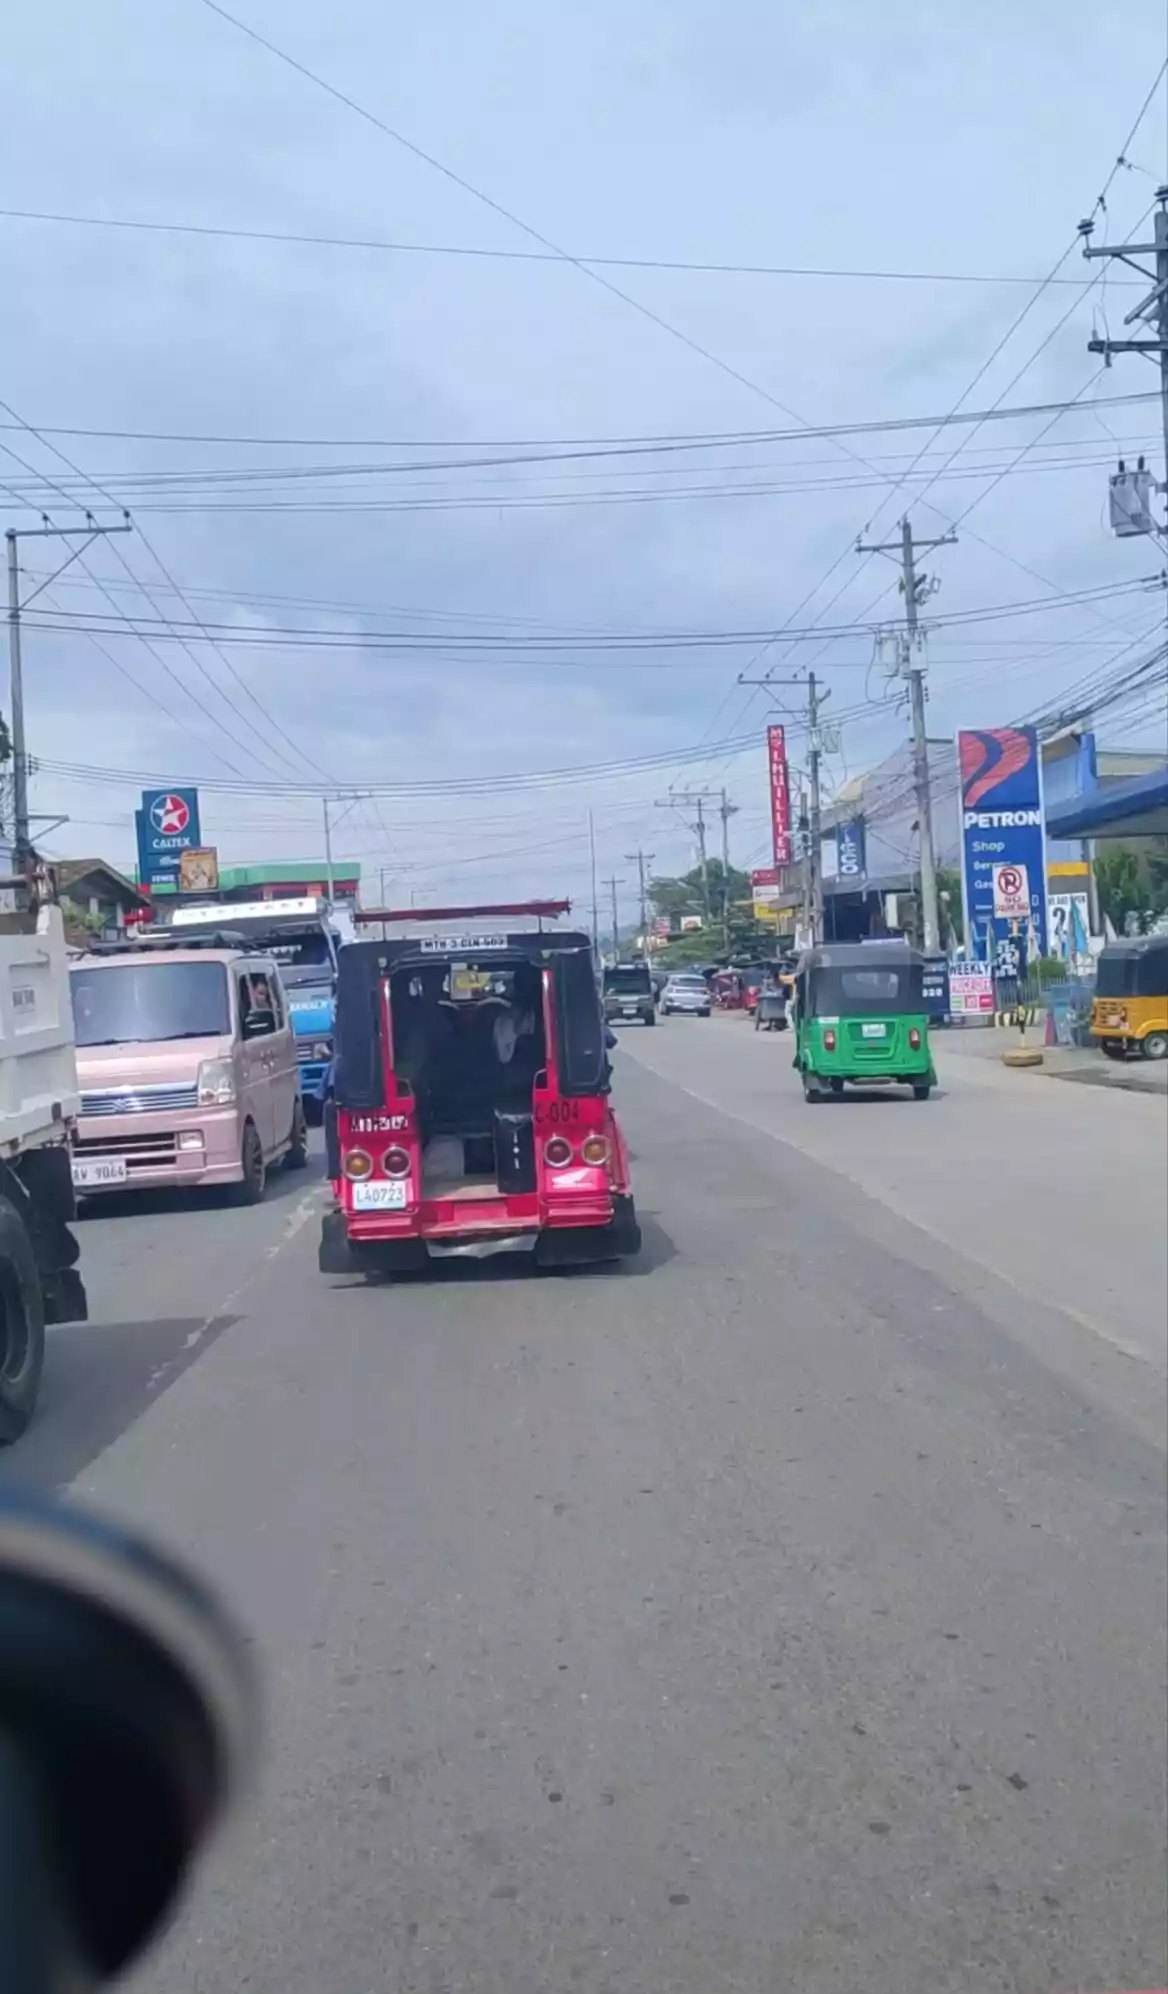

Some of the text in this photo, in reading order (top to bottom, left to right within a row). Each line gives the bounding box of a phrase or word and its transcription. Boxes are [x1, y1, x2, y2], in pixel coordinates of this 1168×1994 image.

[964, 811, 1041, 829] PETRON
[152, 837, 190, 849] CALTEX
[972, 841, 1005, 852] Shop
[950, 962, 991, 976] WEEKLY
